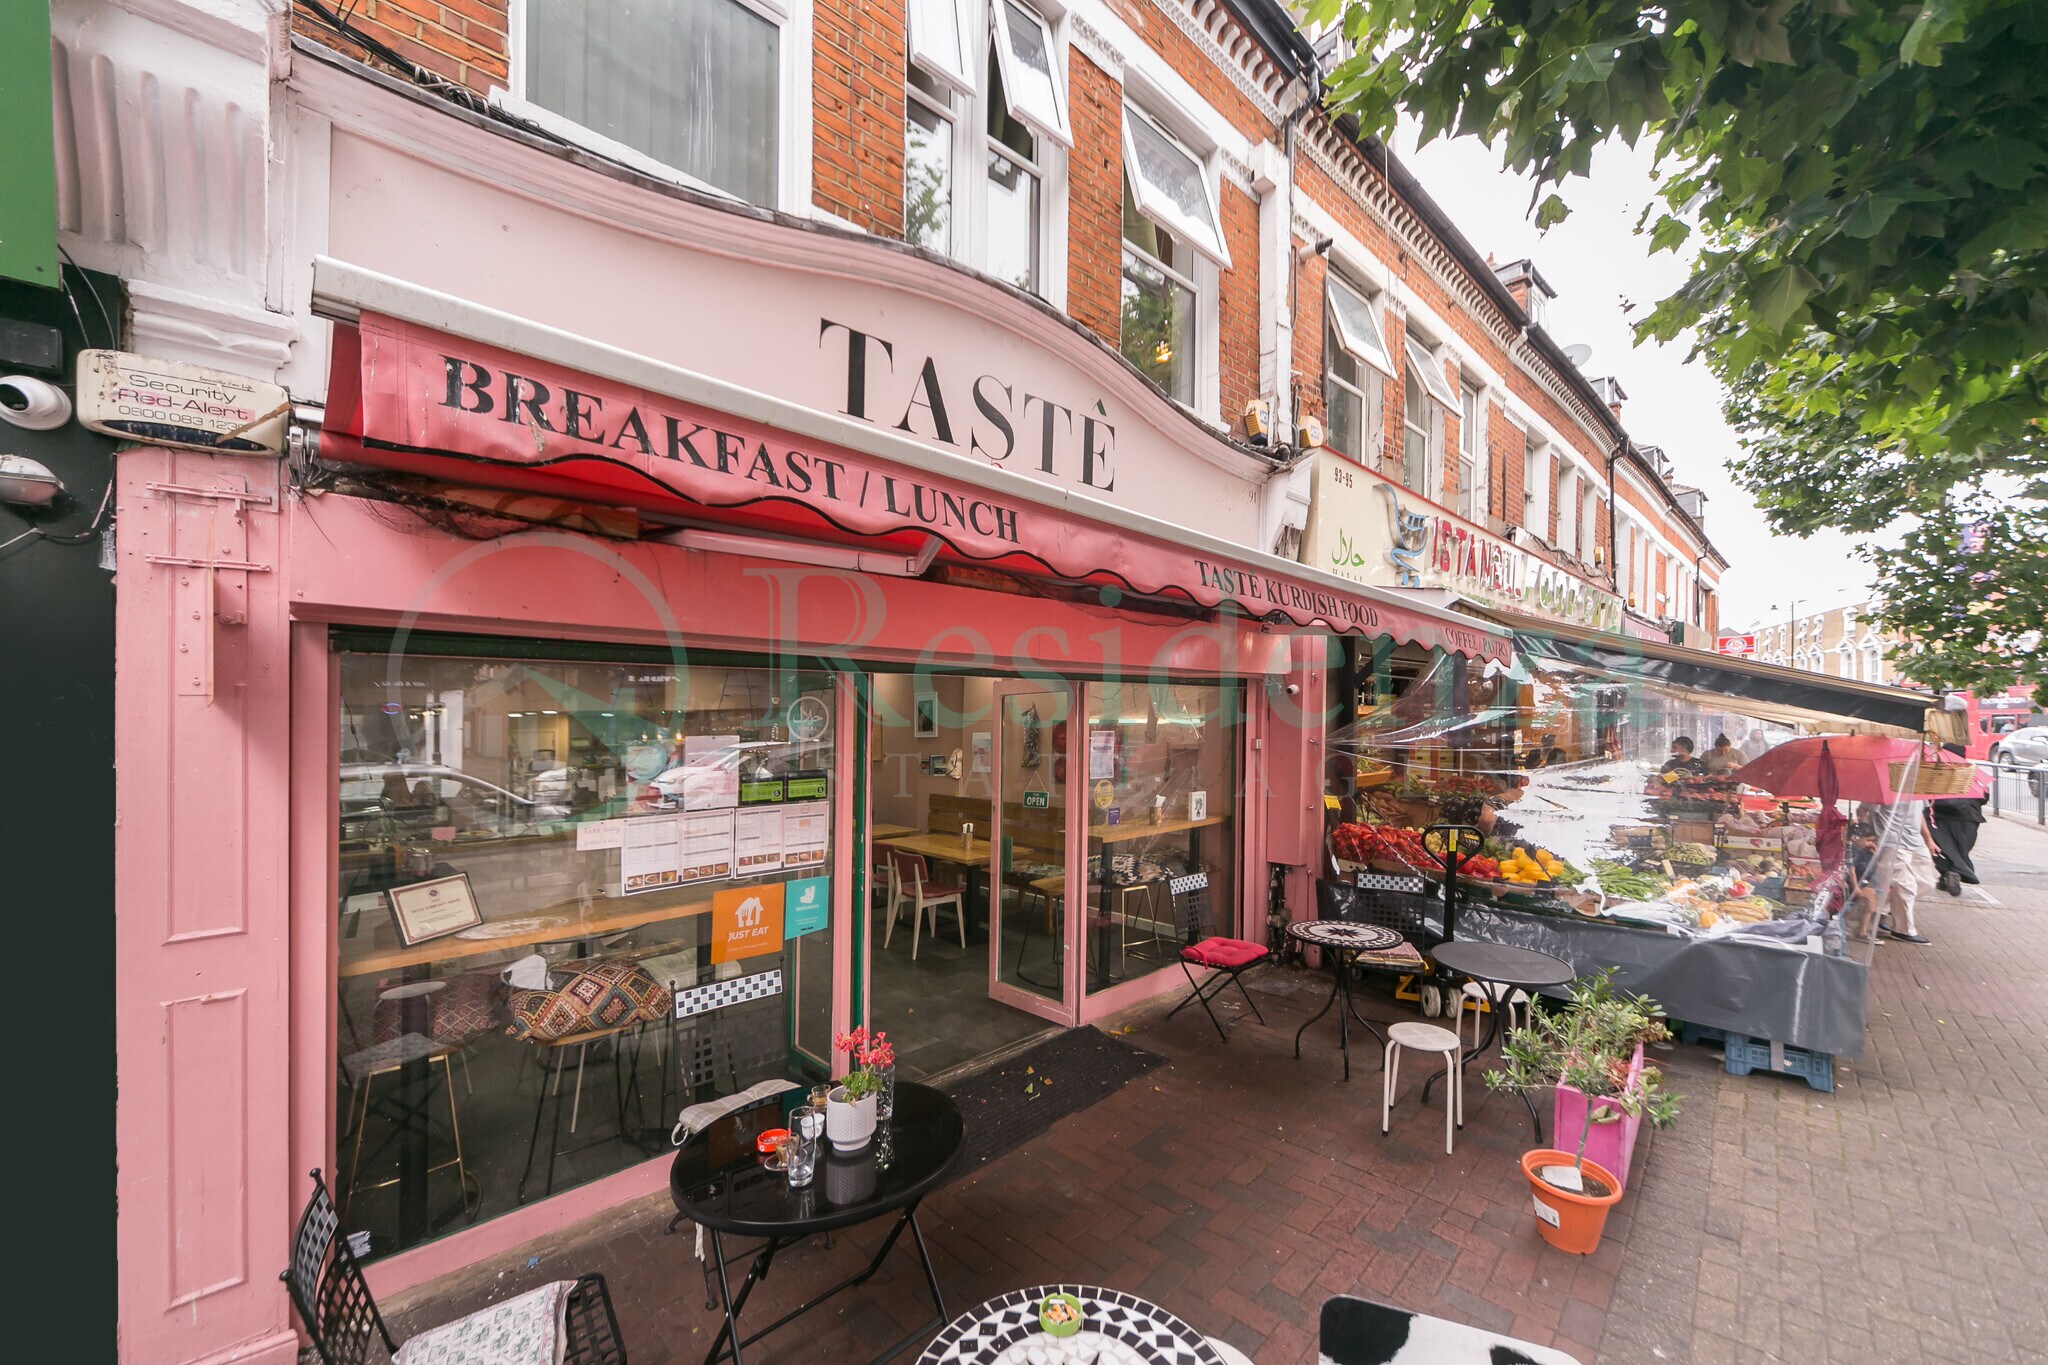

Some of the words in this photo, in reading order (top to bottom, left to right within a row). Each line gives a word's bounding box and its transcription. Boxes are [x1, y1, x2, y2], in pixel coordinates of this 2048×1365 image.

[118, 387, 249, 421] Red-Alert
[129, 374, 237, 405] Security
[118, 405, 166, 421] 0800
[169, 413, 204, 426] 083
[438, 353, 846, 501] BREAKFAST
[881, 474, 1021, 544] LUNCH
[1334, 467, 1353, 489] 93-95
[1249, 490, 1256, 504] 91
[1331, 528, 1366, 567] حلال
[1264, 578, 1341, 618] KURDISH
[1340, 600, 1378, 627] FOOD
[1445, 627, 1478, 651] COFFEE
[1483, 637, 1509, 657] PASTRY
[1026, 796, 1045, 806] OPEN
[727, 929, 750, 942] JUST
[751, 925, 769, 937] EAT
